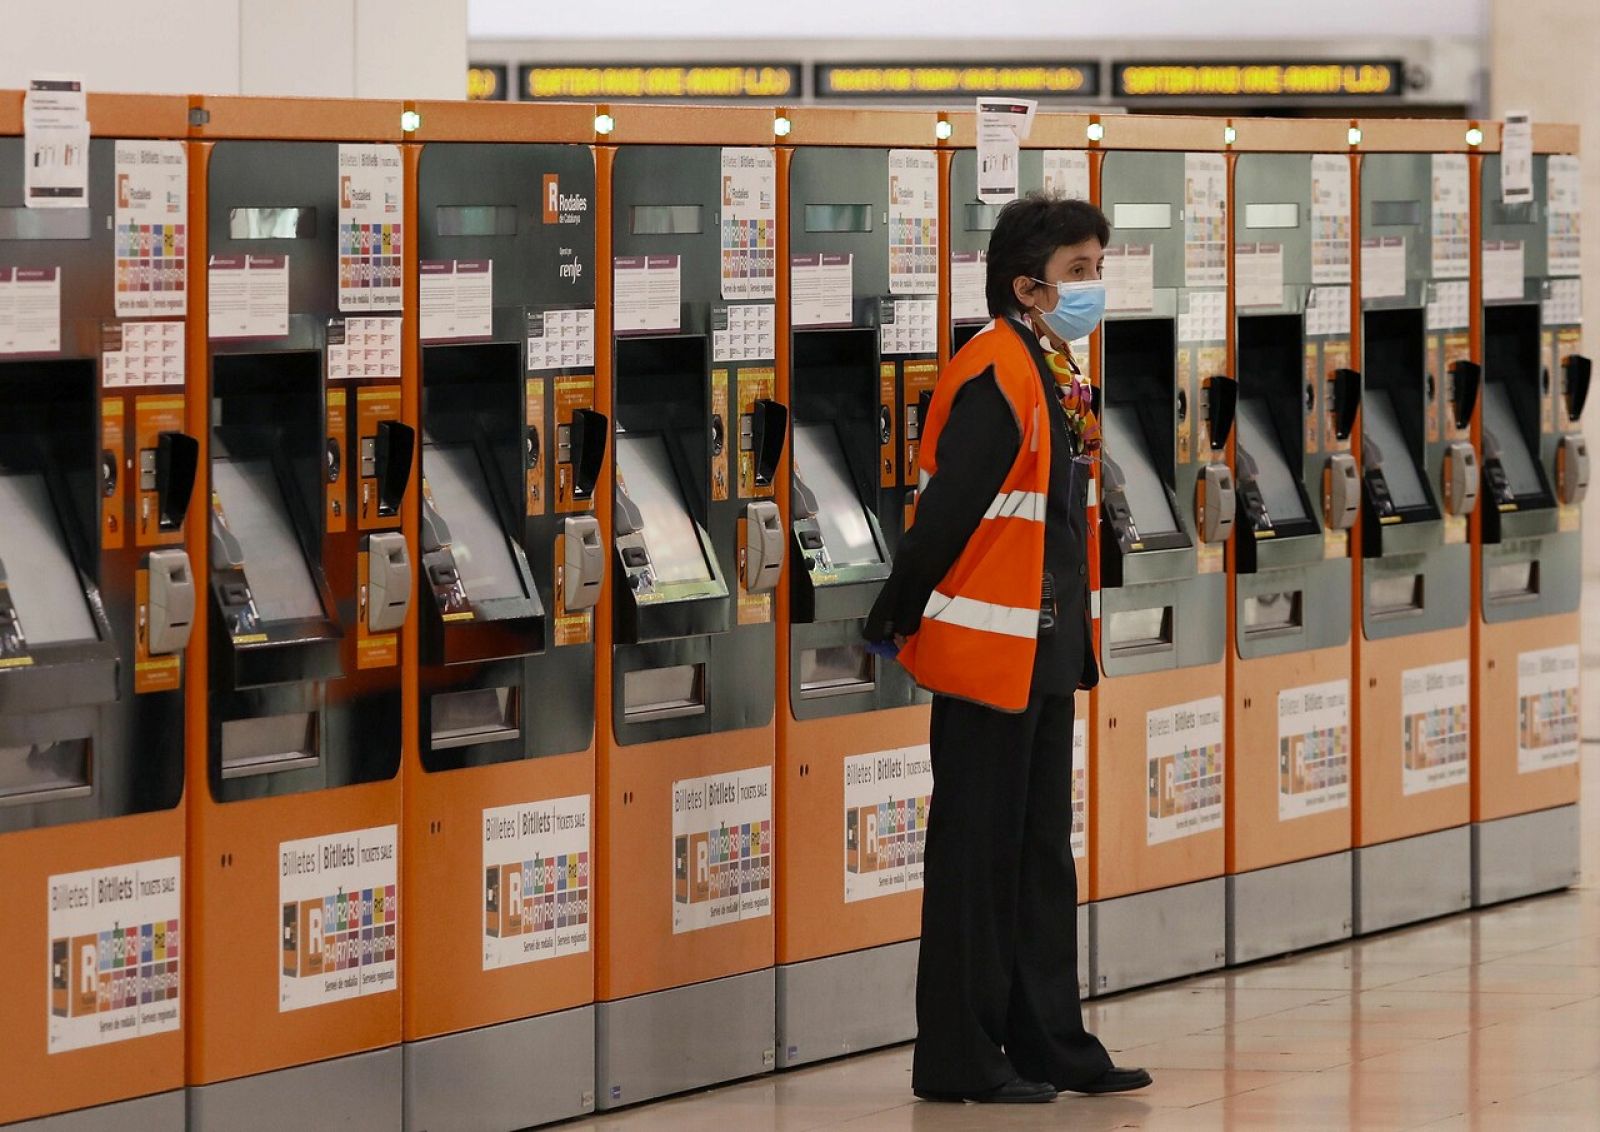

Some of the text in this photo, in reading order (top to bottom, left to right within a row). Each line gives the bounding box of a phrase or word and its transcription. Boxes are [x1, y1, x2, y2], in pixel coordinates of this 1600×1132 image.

[549, 182, 587, 212] R Rodalies
[559, 255, 582, 285] renfe
[847, 765, 872, 786] Billetes
[878, 757, 902, 780] Bitllets
[675, 782, 767, 812] Billetes Bitllets TICKETS SALE
[486, 811, 586, 842] Billetes Bitllets TICKETS SALE
[867, 814, 877, 854] R
[720, 835, 729, 854] R2
[730, 834, 739, 852] R3
[282, 843, 392, 877] Billetes Bitllets TICKETS SALE
[697, 841, 708, 883] R
[524, 867, 533, 887] R1
[534, 867, 544, 886] R2
[544, 865, 554, 884] R3
[52, 876, 175, 911] Billetes Bitllets TICKETS SALE
[509, 872, 521, 916] R
[325, 902, 336, 921] R1
[337, 902, 347, 923] R2
[348, 899, 359, 921] R3
[524, 906, 533, 926] R4
[533, 904, 544, 923] R7
[544, 902, 554, 921] R8
[309, 908, 323, 955] R
[325, 943, 336, 964] R4
[336, 941, 347, 962] R7
[348, 938, 360, 959] R8
[80, 944, 97, 993] R
